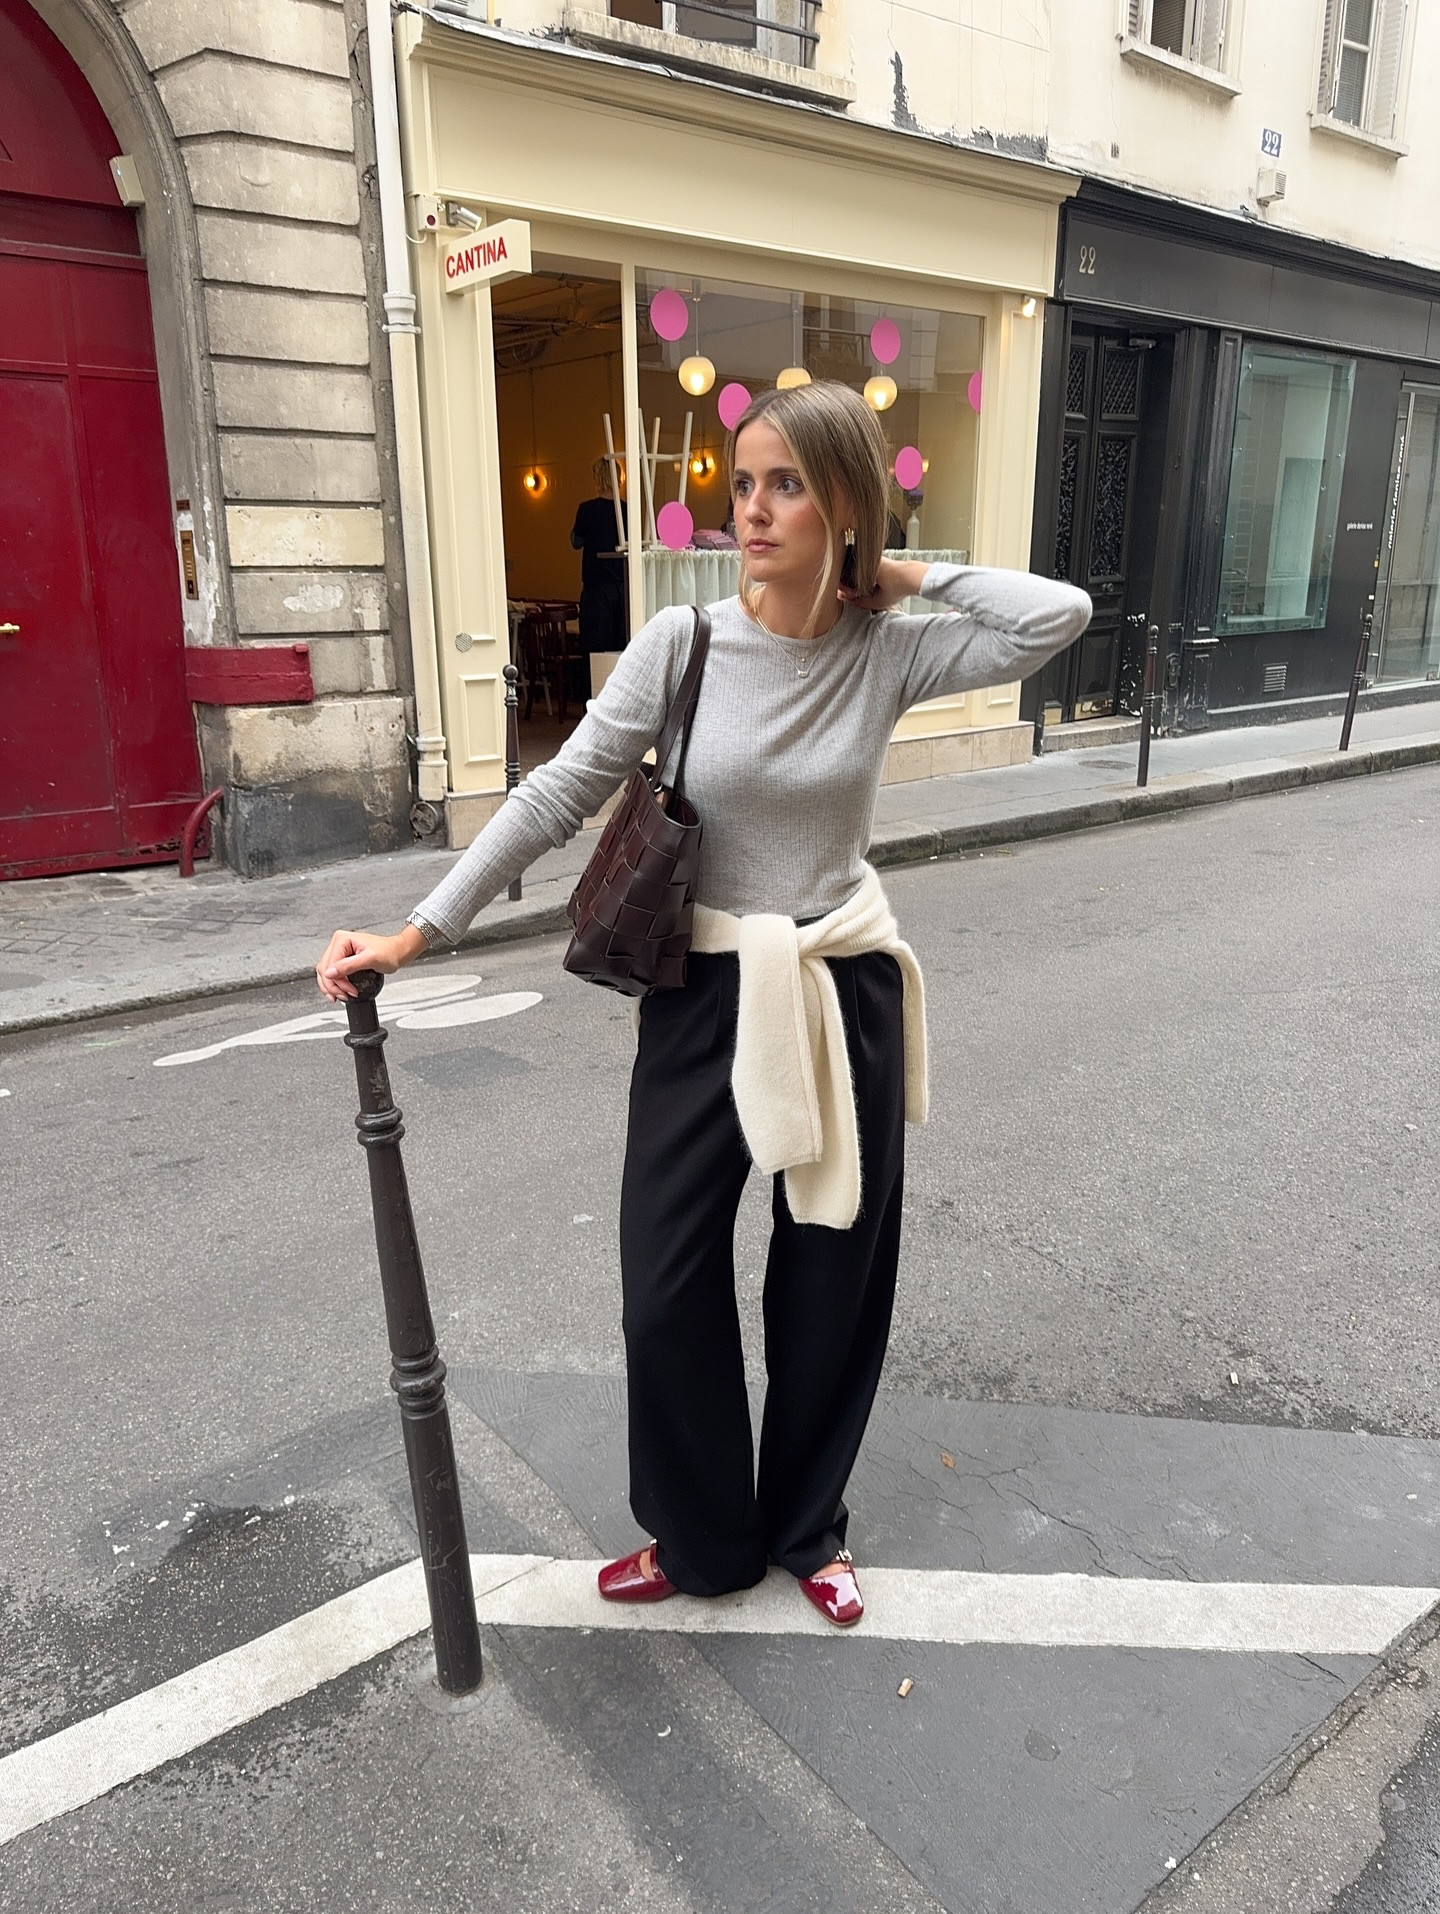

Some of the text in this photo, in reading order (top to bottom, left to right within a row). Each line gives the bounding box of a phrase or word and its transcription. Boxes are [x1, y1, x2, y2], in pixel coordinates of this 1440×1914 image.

[1264, 130, 1279, 156] 22
[446, 236, 508, 279] CANTINA
[1079, 245, 1096, 275] 22
